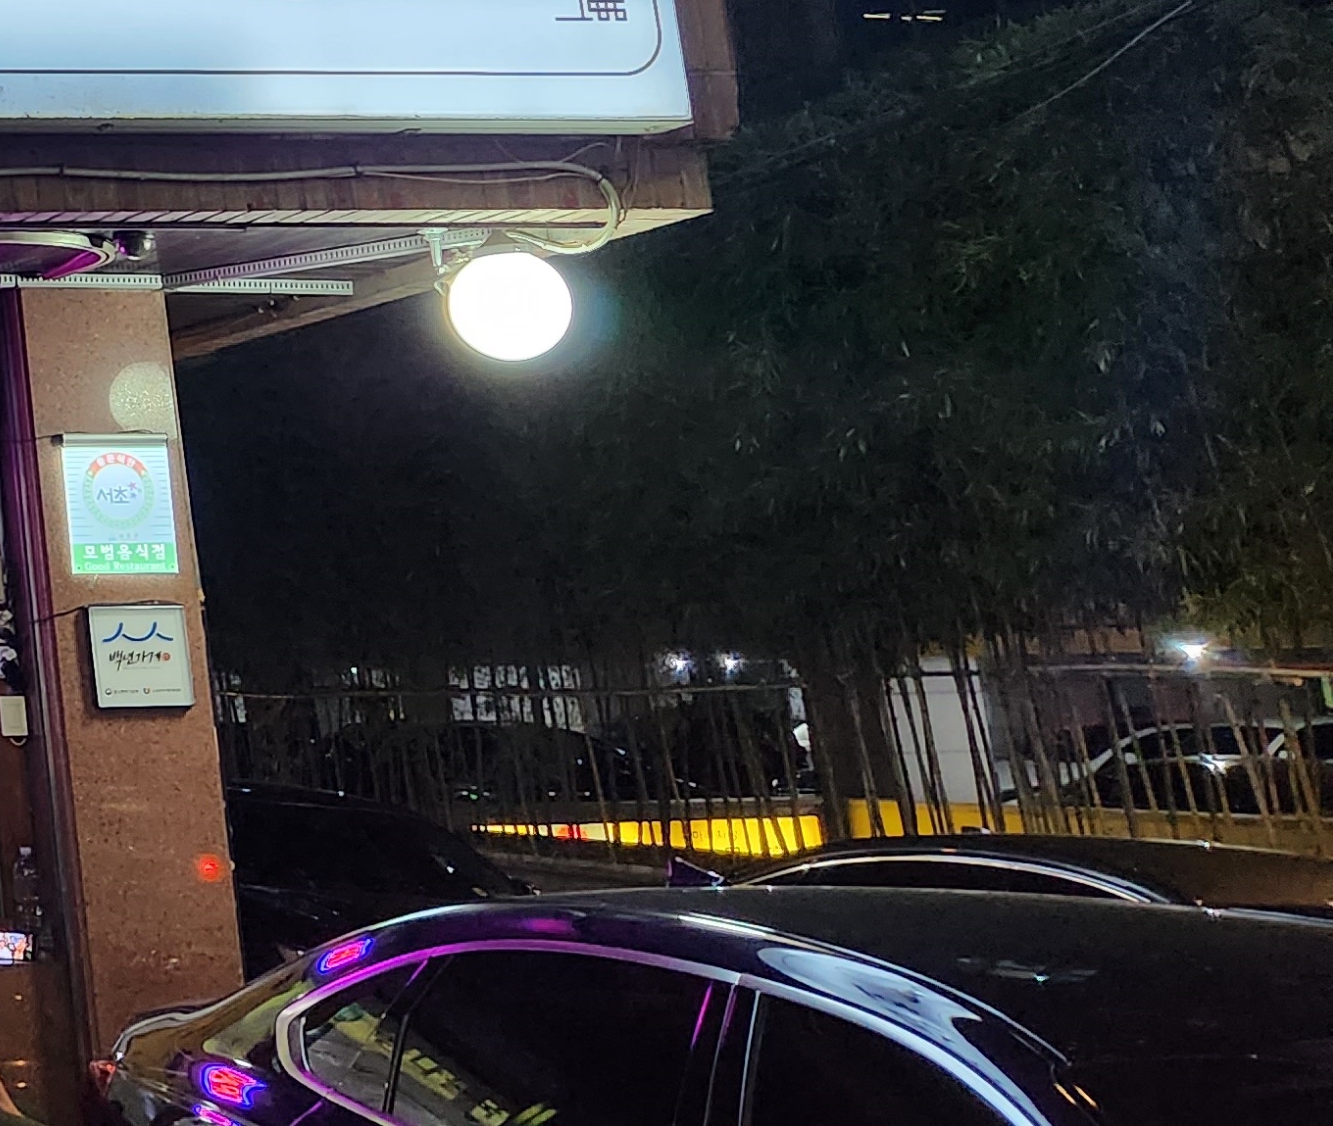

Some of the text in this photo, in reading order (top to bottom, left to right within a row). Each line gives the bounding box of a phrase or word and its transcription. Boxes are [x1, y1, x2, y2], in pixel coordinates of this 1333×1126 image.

[96, 485, 131, 504] 서초
[83, 543, 166, 561] 모범음식점
[84, 561, 166, 571] Good Restaurant
[108, 650, 162, 672] 백년가게
